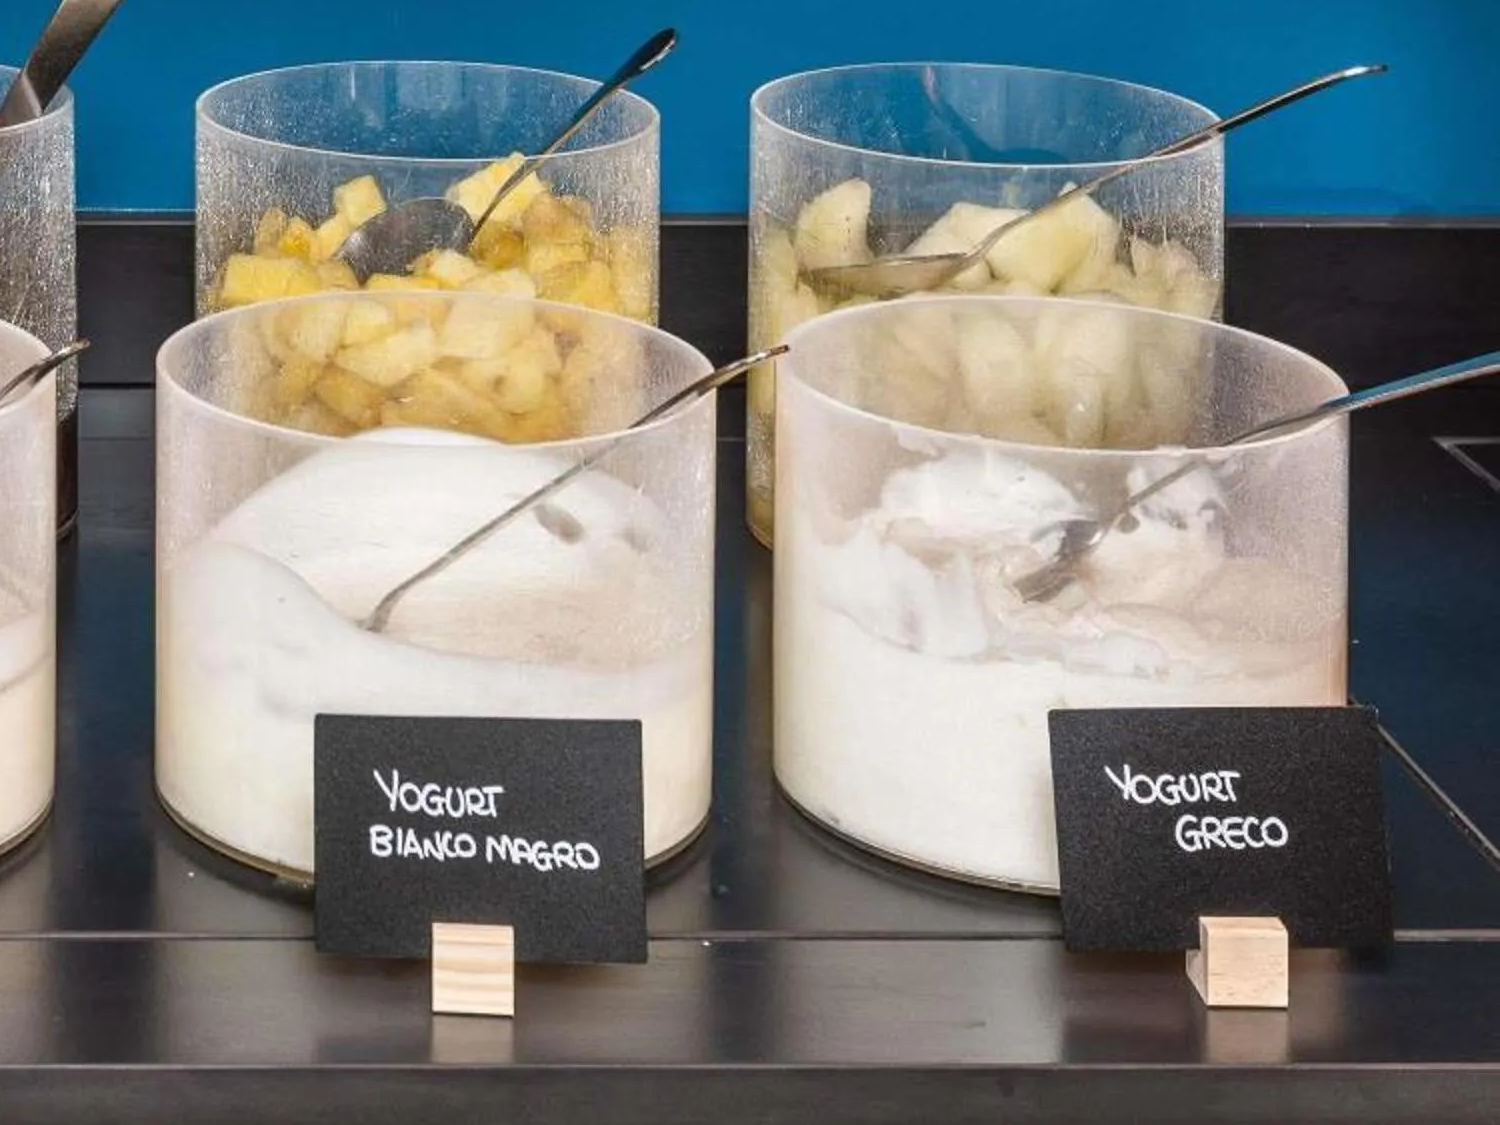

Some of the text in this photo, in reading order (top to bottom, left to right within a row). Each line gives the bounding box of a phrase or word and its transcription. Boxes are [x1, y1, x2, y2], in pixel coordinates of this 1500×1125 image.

[372, 768, 505, 819] YOGURT
[1103, 763, 1241, 806] YOGURT
[368, 823, 601, 873] BIANCO MAGRO
[1174, 813, 1289, 853] GRECO
